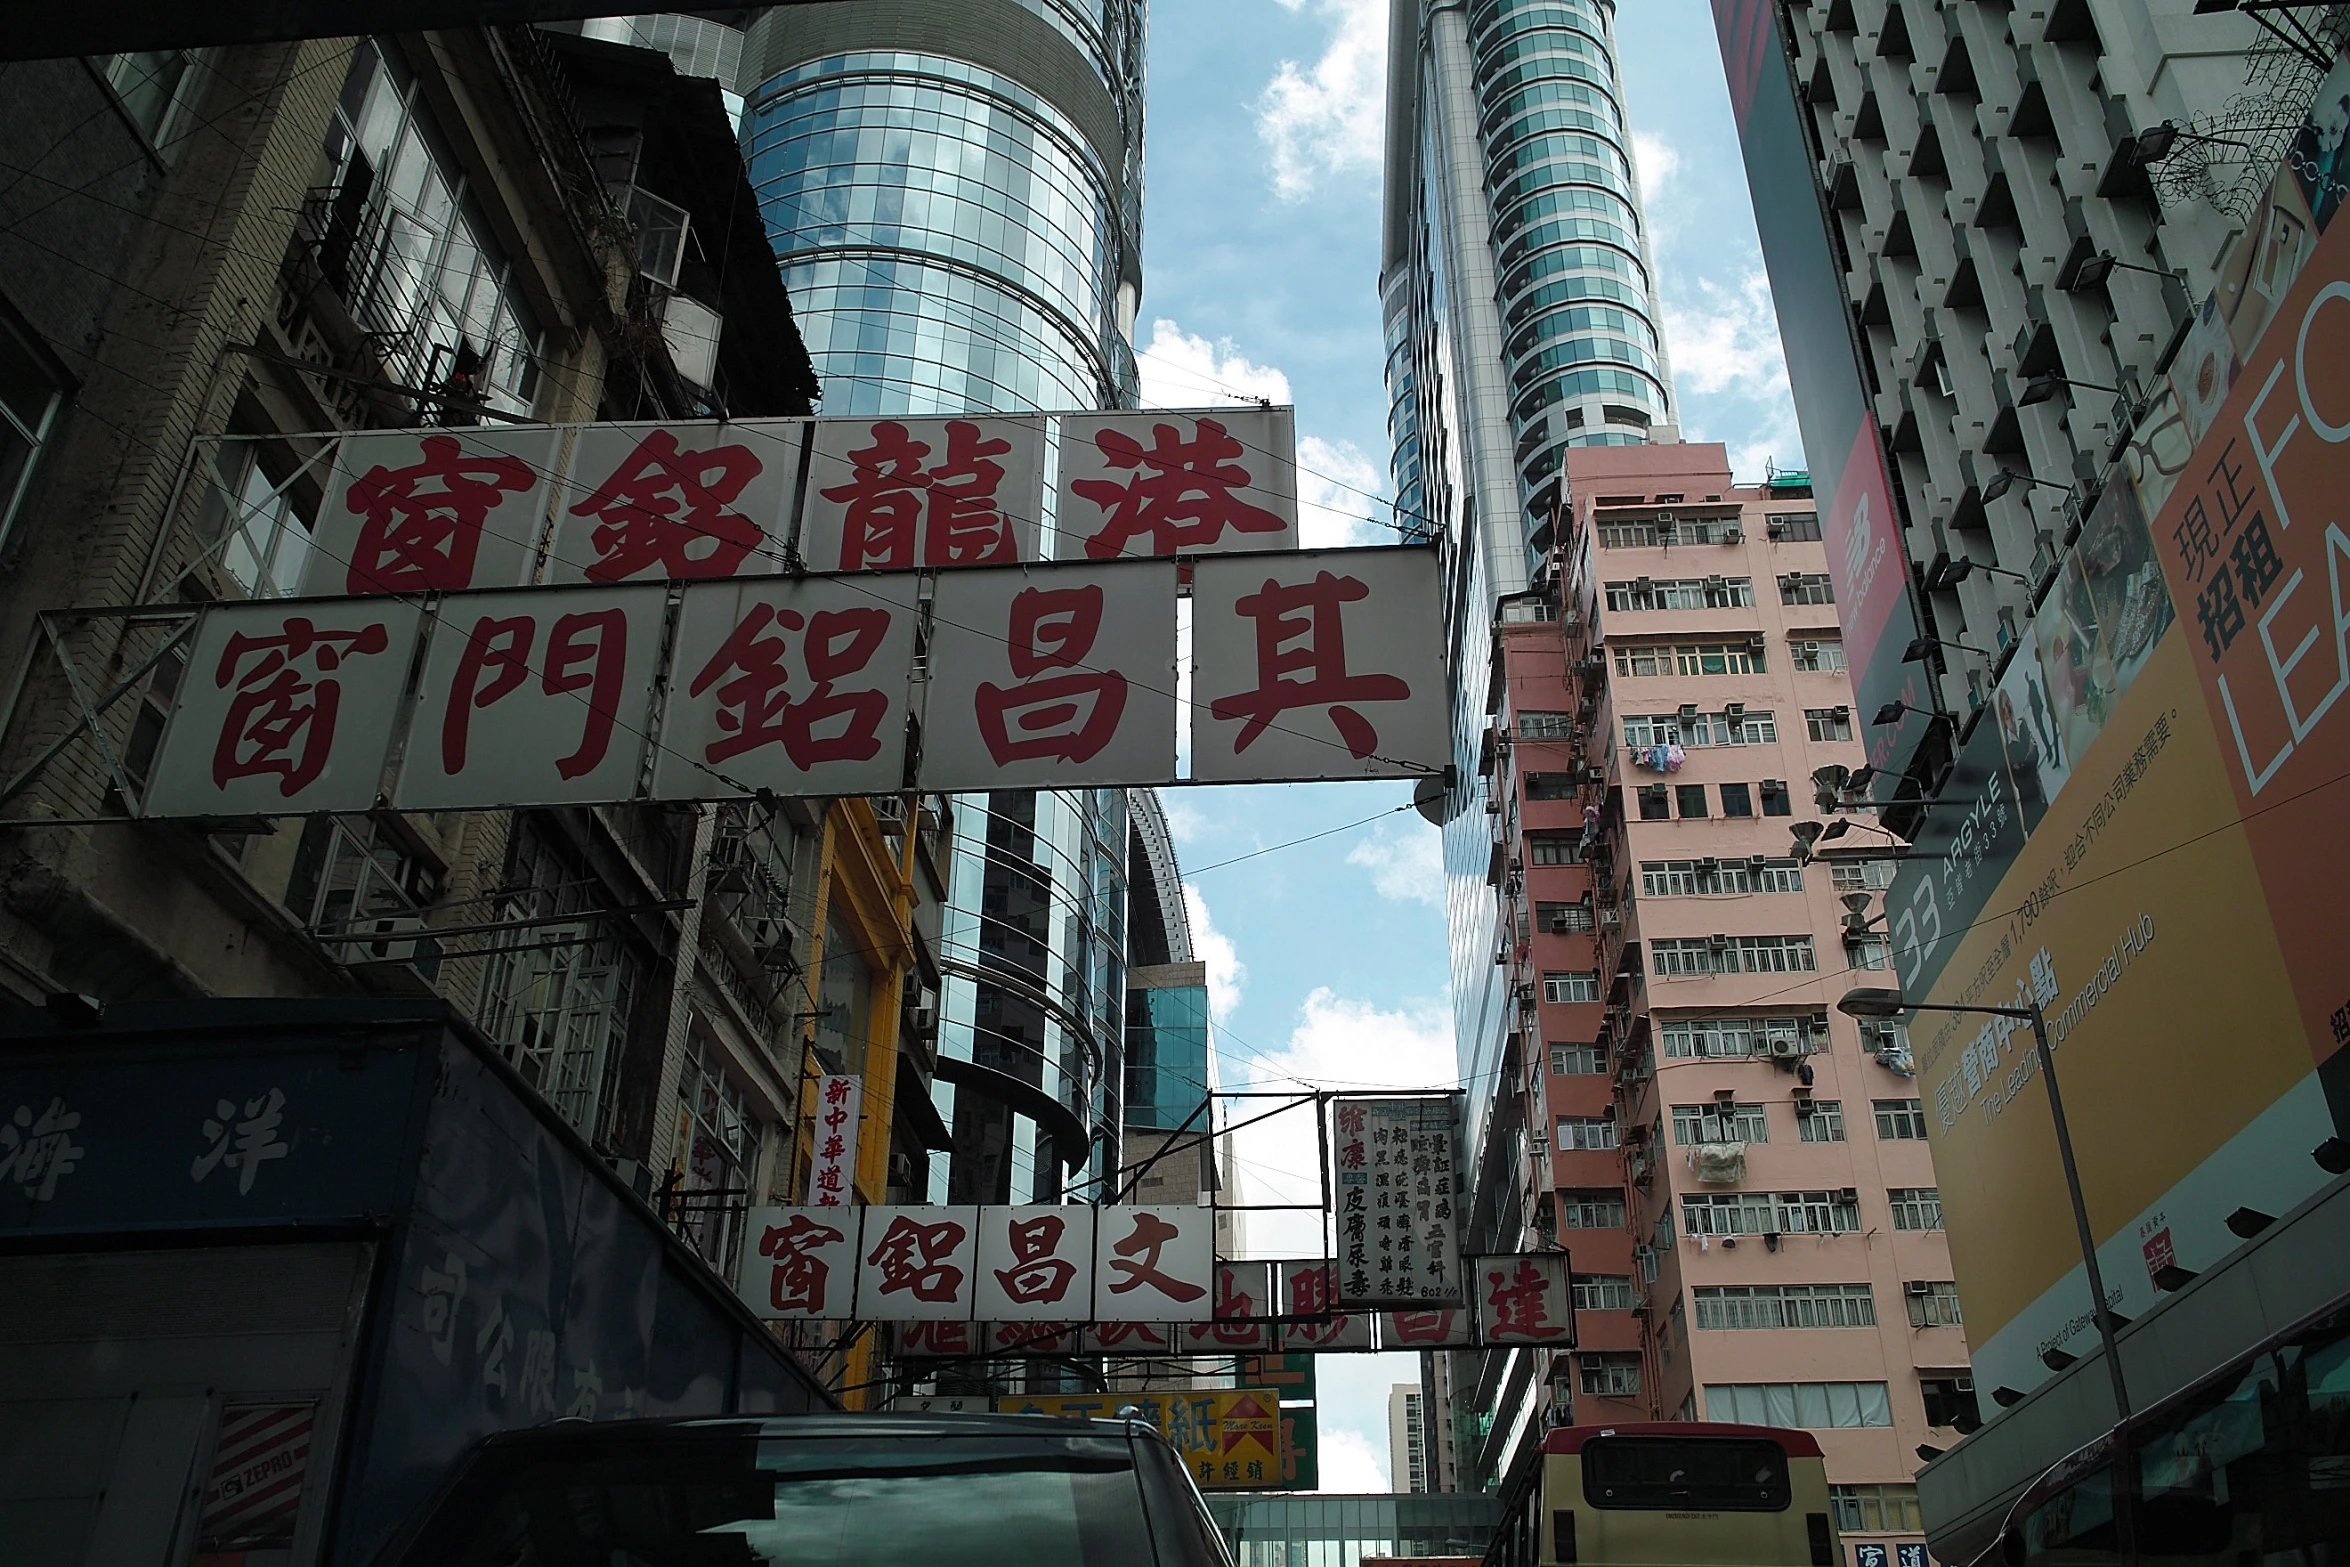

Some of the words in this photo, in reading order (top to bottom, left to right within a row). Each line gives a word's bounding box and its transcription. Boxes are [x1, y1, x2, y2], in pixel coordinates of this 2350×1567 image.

[2172, 437, 2257, 584] 現正
[2196, 508, 2286, 666] 招租
[1895, 873, 1943, 991] 33
[1942, 770, 2001, 885] ARGYLE
[1979, 1089, 2004, 1127] The
[2045, 944, 2124, 1052] Commercial
[2118, 911, 2156, 968] Hub
[1420, 1285, 1442, 1298] 602
[243, 1450, 293, 1489] ZEPRO
